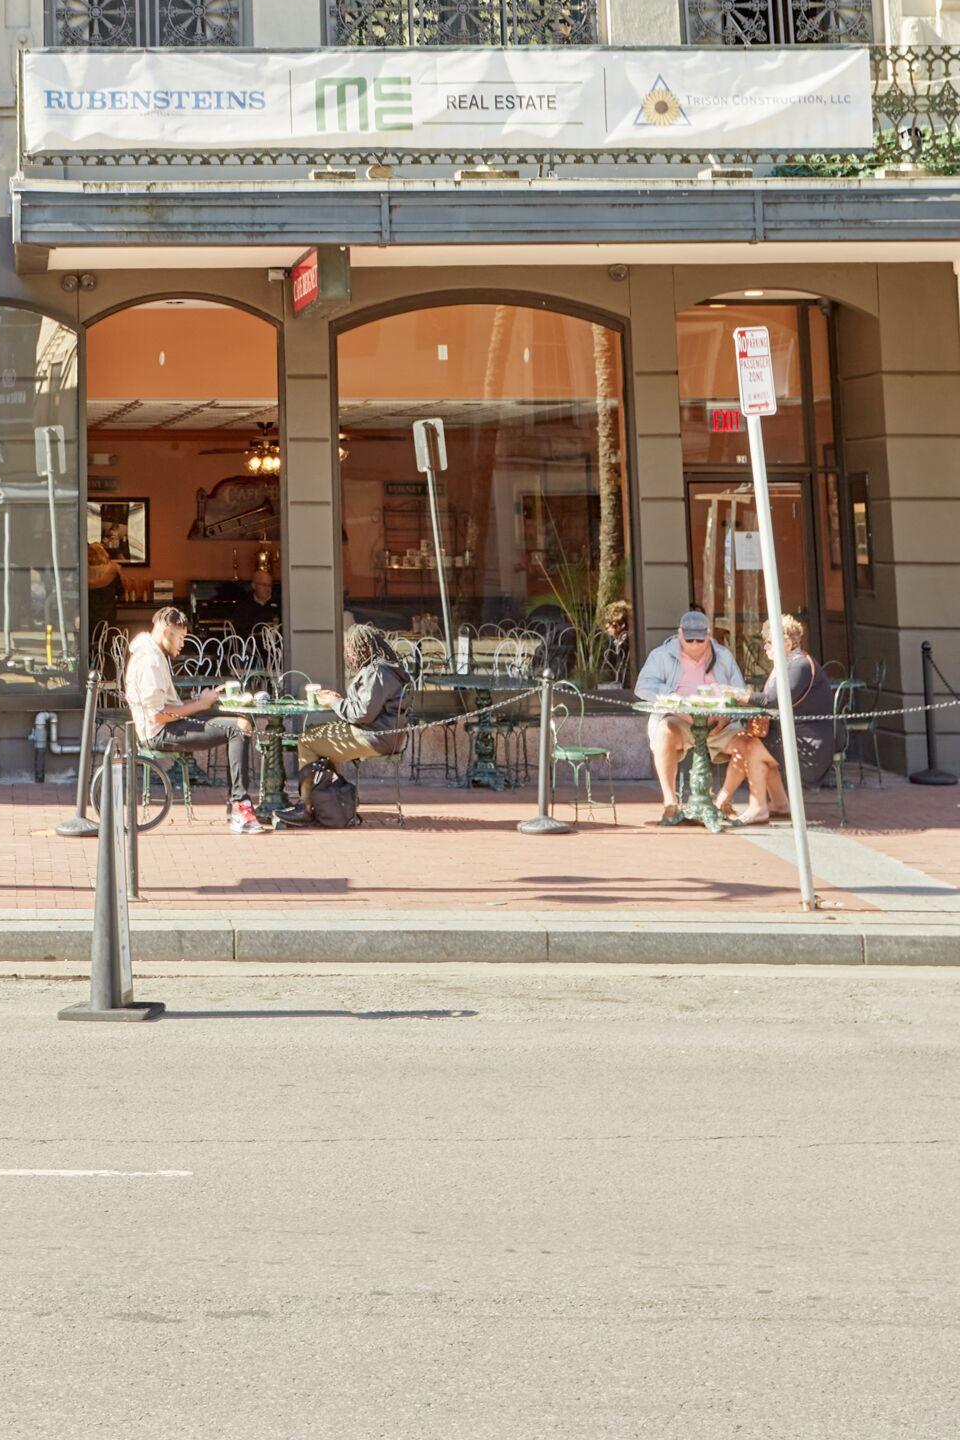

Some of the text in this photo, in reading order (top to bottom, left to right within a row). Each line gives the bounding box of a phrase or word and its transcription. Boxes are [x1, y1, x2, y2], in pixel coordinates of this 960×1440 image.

[43, 90, 266, 110] RUBENSTEINS
[446, 94, 557, 110] REAL ESTATE
[830, 94, 852, 105] LLC
[738, 335, 748, 353] NO
[748, 371, 764, 383] ZONE
[712, 409, 740, 433] EXIT
